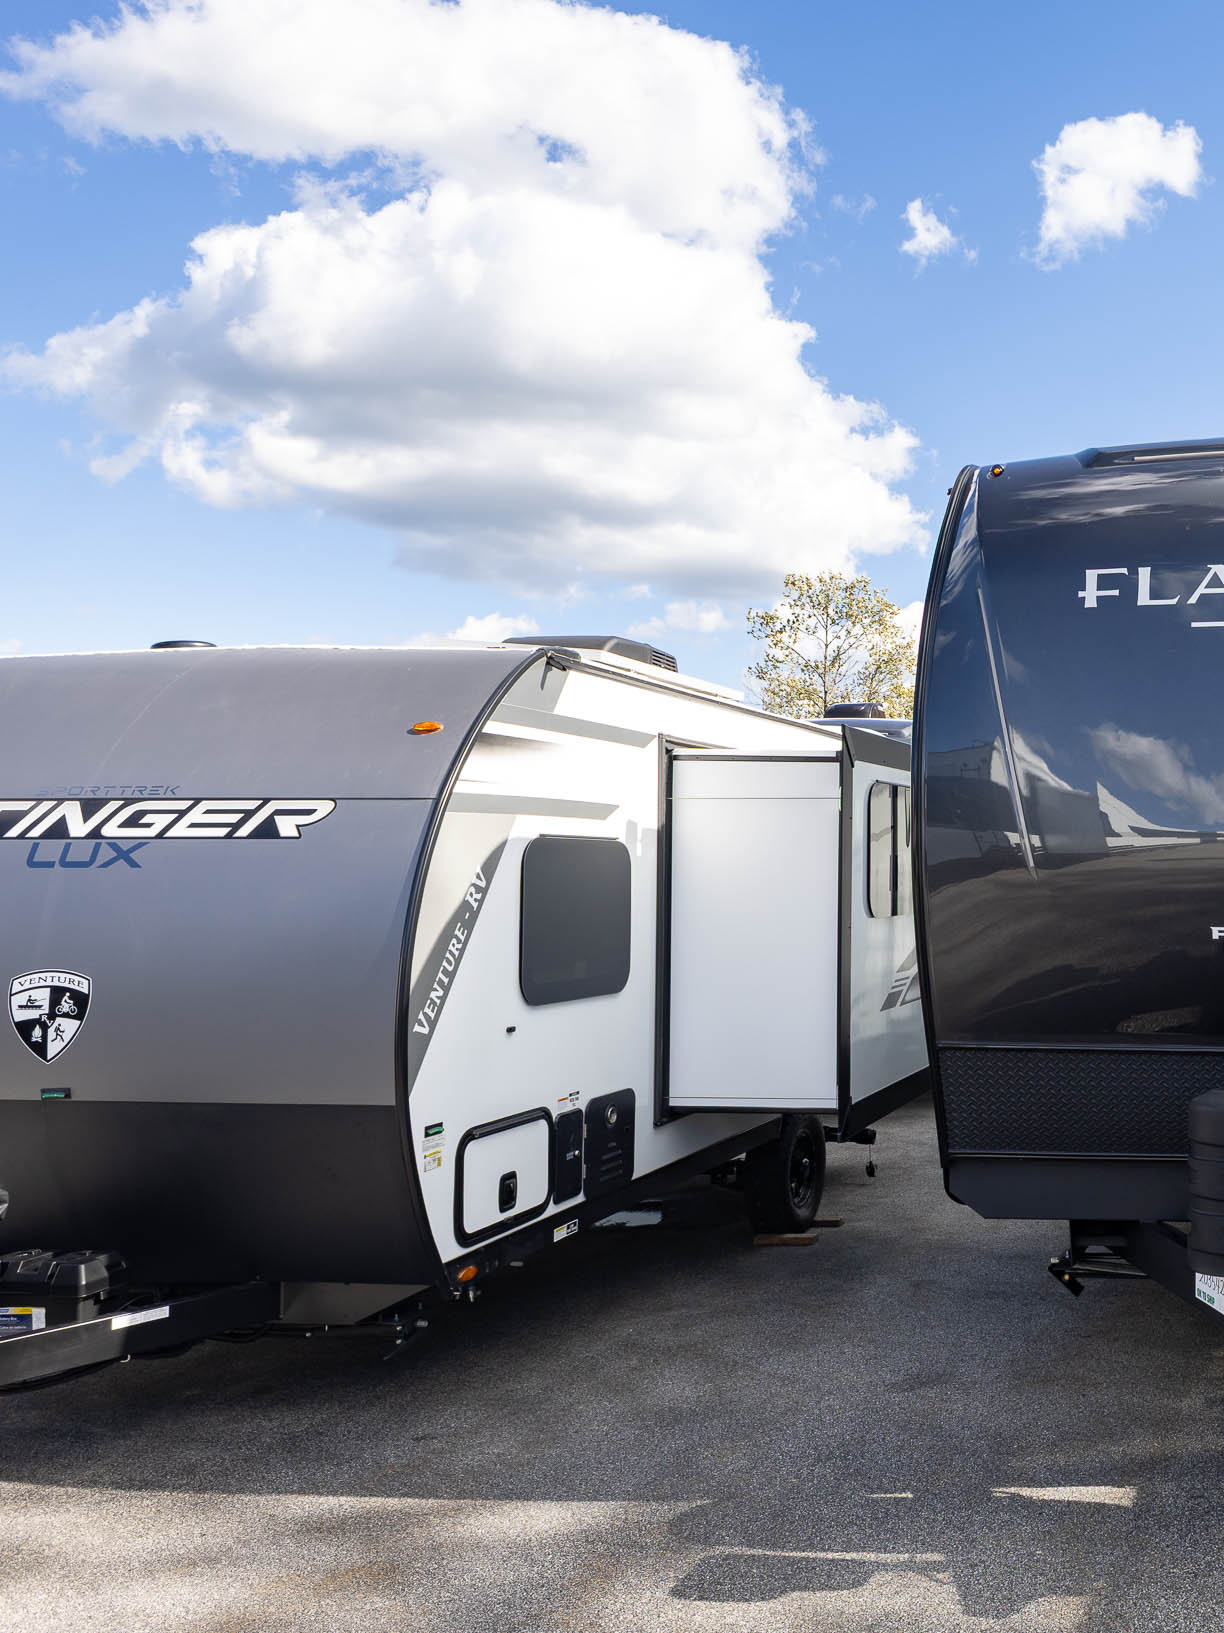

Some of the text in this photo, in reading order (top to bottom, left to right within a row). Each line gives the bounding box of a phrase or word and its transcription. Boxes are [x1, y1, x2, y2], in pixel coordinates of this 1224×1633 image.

[26, 841, 151, 869] LUX
[413, 922, 468, 1036] VENTURE
[464, 864, 488, 912] RV
[18, 975, 86, 989] VENTURE
